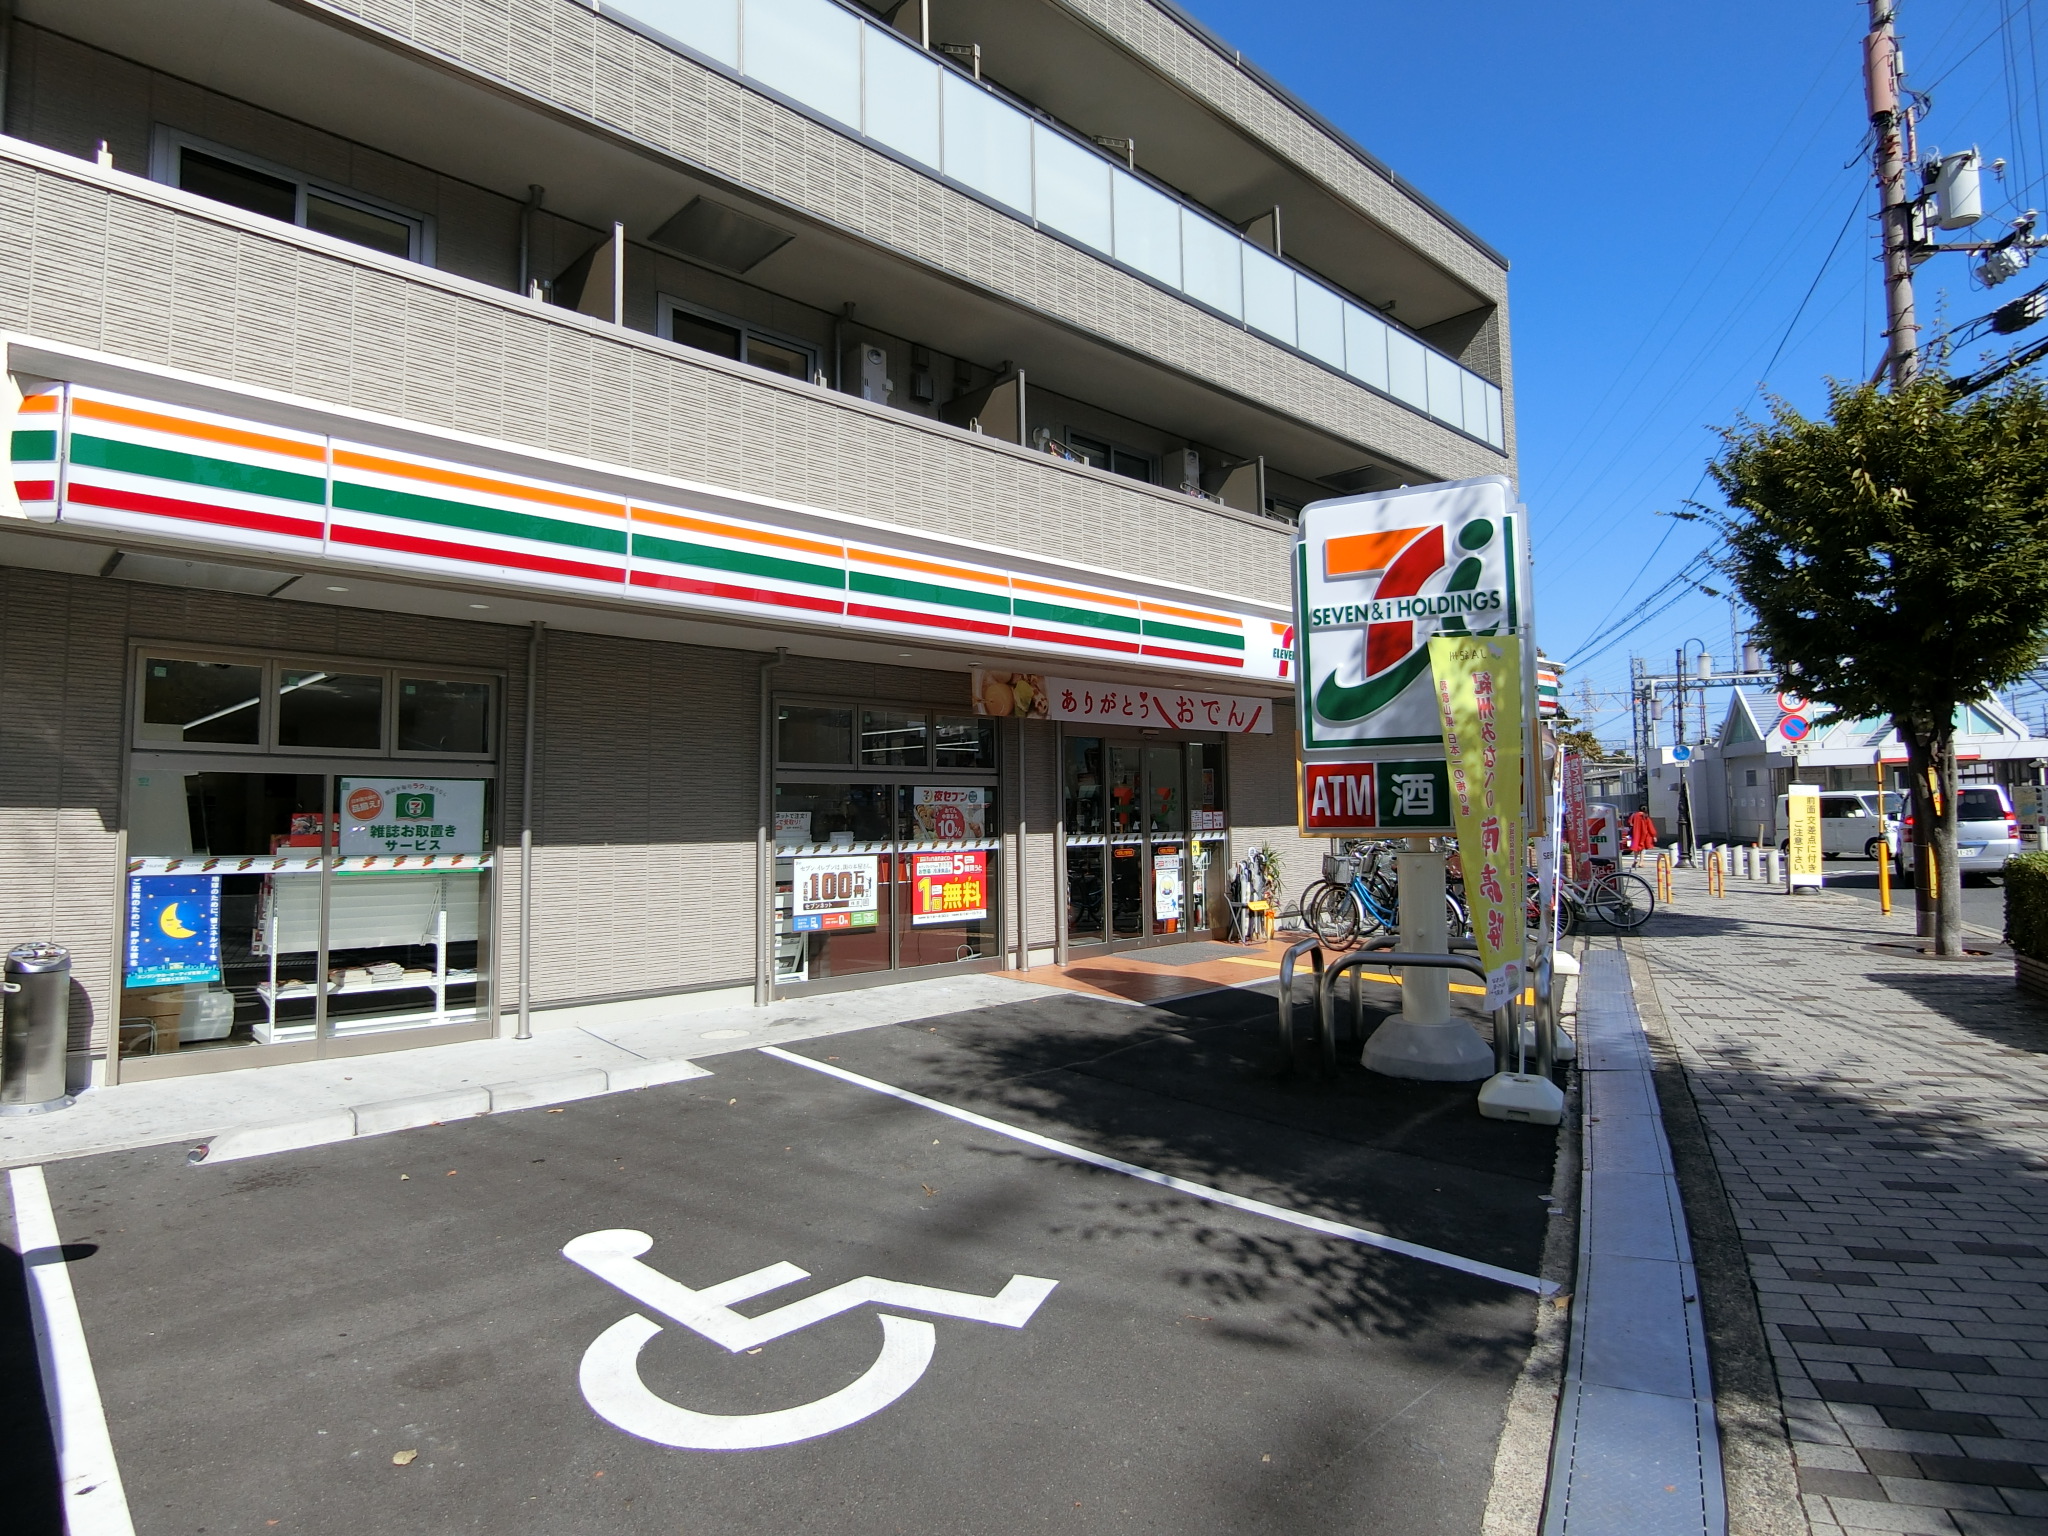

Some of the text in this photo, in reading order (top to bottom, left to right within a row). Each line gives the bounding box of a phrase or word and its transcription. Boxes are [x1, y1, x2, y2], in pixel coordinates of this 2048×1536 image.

[1399, 590, 1501, 618] HOLDINGS
[1273, 648, 1295, 660] ELEVE
[1061, 688, 1245, 727] ありがとう おでん
[934, 790, 968, 803] 夜セブン
[1311, 774, 1371, 817] ATM
[1391, 773, 1435, 817] 酒
[370, 824, 457, 838] 雑誌お取置き
[938, 819, 963, 837] 10%
[385, 839, 441, 851] サービス
[1793, 820, 1806, 874] ご注意下さい。
